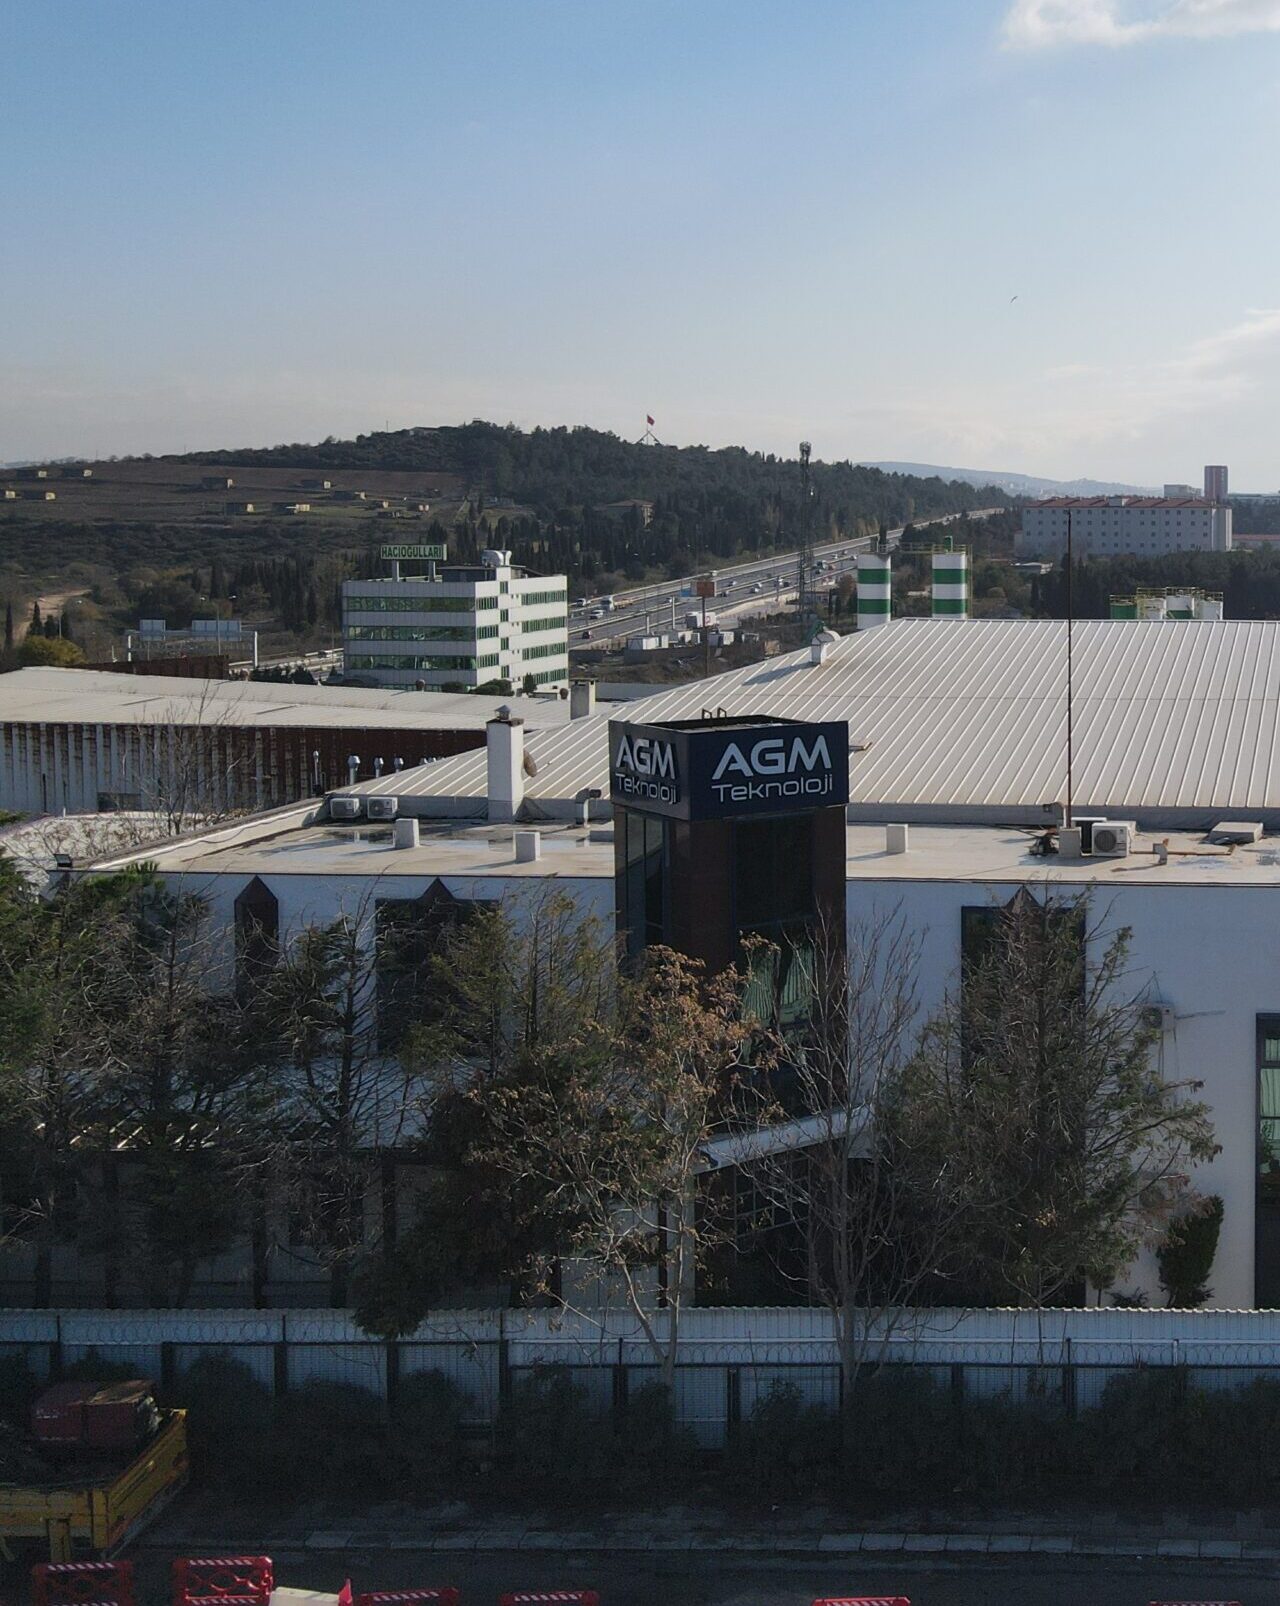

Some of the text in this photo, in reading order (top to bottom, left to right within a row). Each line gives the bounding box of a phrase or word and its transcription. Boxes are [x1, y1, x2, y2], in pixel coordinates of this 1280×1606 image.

[616, 735, 676, 780] AGM
[712, 735, 832, 780] AGM
[616, 773, 677, 804] Teknoloji
[712, 774, 833, 803] Teknoloji
